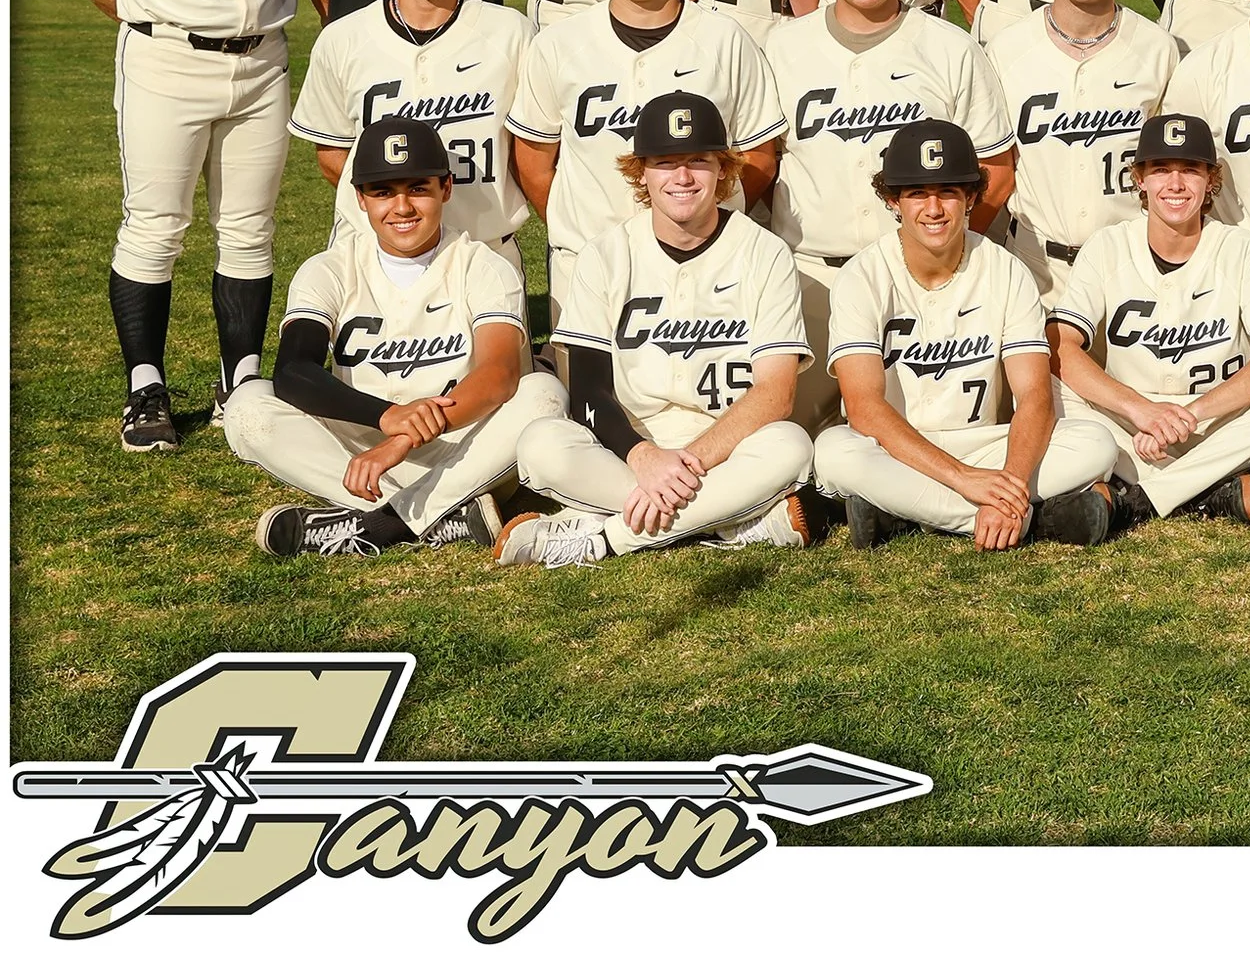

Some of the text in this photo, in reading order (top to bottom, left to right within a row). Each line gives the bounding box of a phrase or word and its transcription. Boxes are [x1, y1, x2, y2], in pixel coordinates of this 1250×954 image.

[363, 80, 494, 130] Canyon
[668, 109, 691, 139] C
[796, 88, 924, 143] Canyon
[1017, 93, 1142, 147] Canyon
[384, 135, 409, 164] C
[920, 140, 944, 170] C
[1163, 120, 1186, 146] C
[450, 138, 495, 184] 31
[338, 317, 465, 381] Canyon
[617, 297, 748, 358] Canyon
[883, 319, 994, 379] Canyon
[1108, 300, 1231, 363] Canyon
[697, 362, 753, 410] 45
[963, 381, 987, 423] 7
